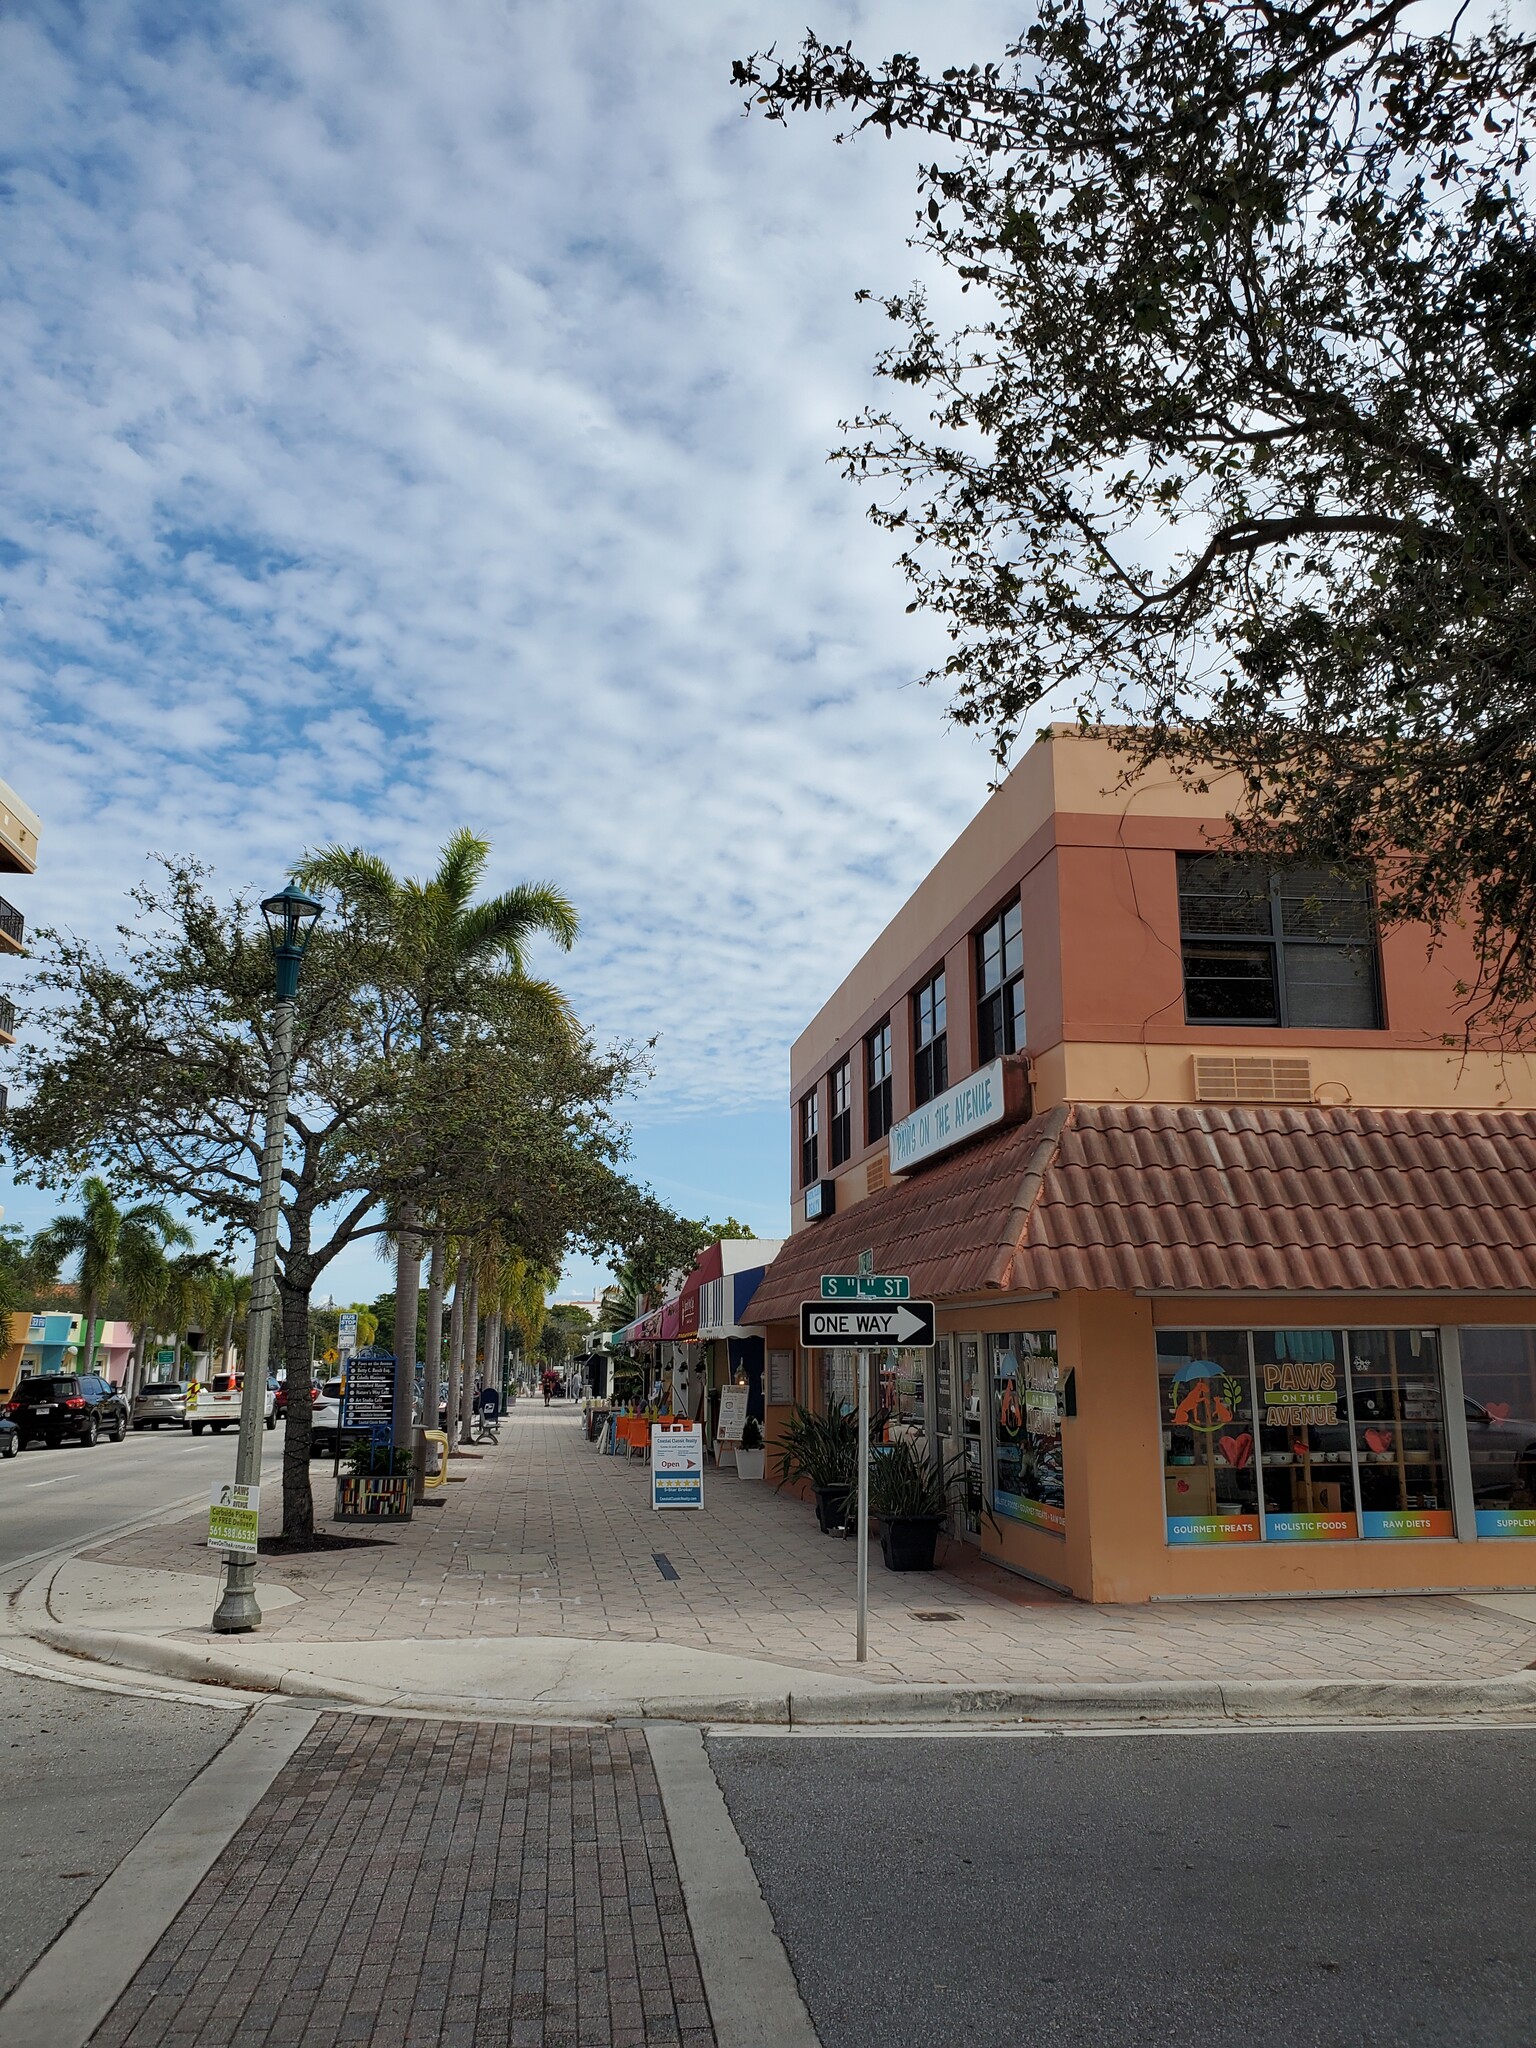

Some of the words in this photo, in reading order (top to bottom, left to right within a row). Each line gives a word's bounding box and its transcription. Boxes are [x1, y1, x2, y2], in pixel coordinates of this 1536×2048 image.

[897, 1123, 916, 1160] PAWS
[920, 1114, 930, 1147] ON
[935, 1103, 950, 1139] THE
[955, 1078, 993, 1128] AVENUE
[828, 1279, 838, 1295] S
[884, 1279, 902, 1296] ST
[814, 1316, 849, 1333] ONE
[856, 1316, 892, 1333] WAY
[967, 1347, 976, 1357] 525
[1263, 1363, 1336, 1391] PAWS
[1282, 1394, 1297, 1402] ON
[1300, 1394, 1321, 1402] THE
[1266, 1406, 1338, 1426] AVENUE
[234, 1486, 249, 1496] PAWS
[212, 1508, 234, 1518] Curbside
[236, 1511, 253, 1521] Pickup
[218, 1517, 231, 1525] FREE
[233, 1518, 254, 1529] Delivery
[1173, 1525, 1217, 1534] GOURMET
[1219, 1523, 1253, 1533] TREATS
[1274, 1522, 1315, 1531] HOLISTIC
[1316, 1522, 1348, 1530] FOODS
[1383, 1520, 1405, 1528] RAW
[1406, 1519, 1431, 1528] DIETS
[210, 1526, 255, 1540] 561.588.6533
